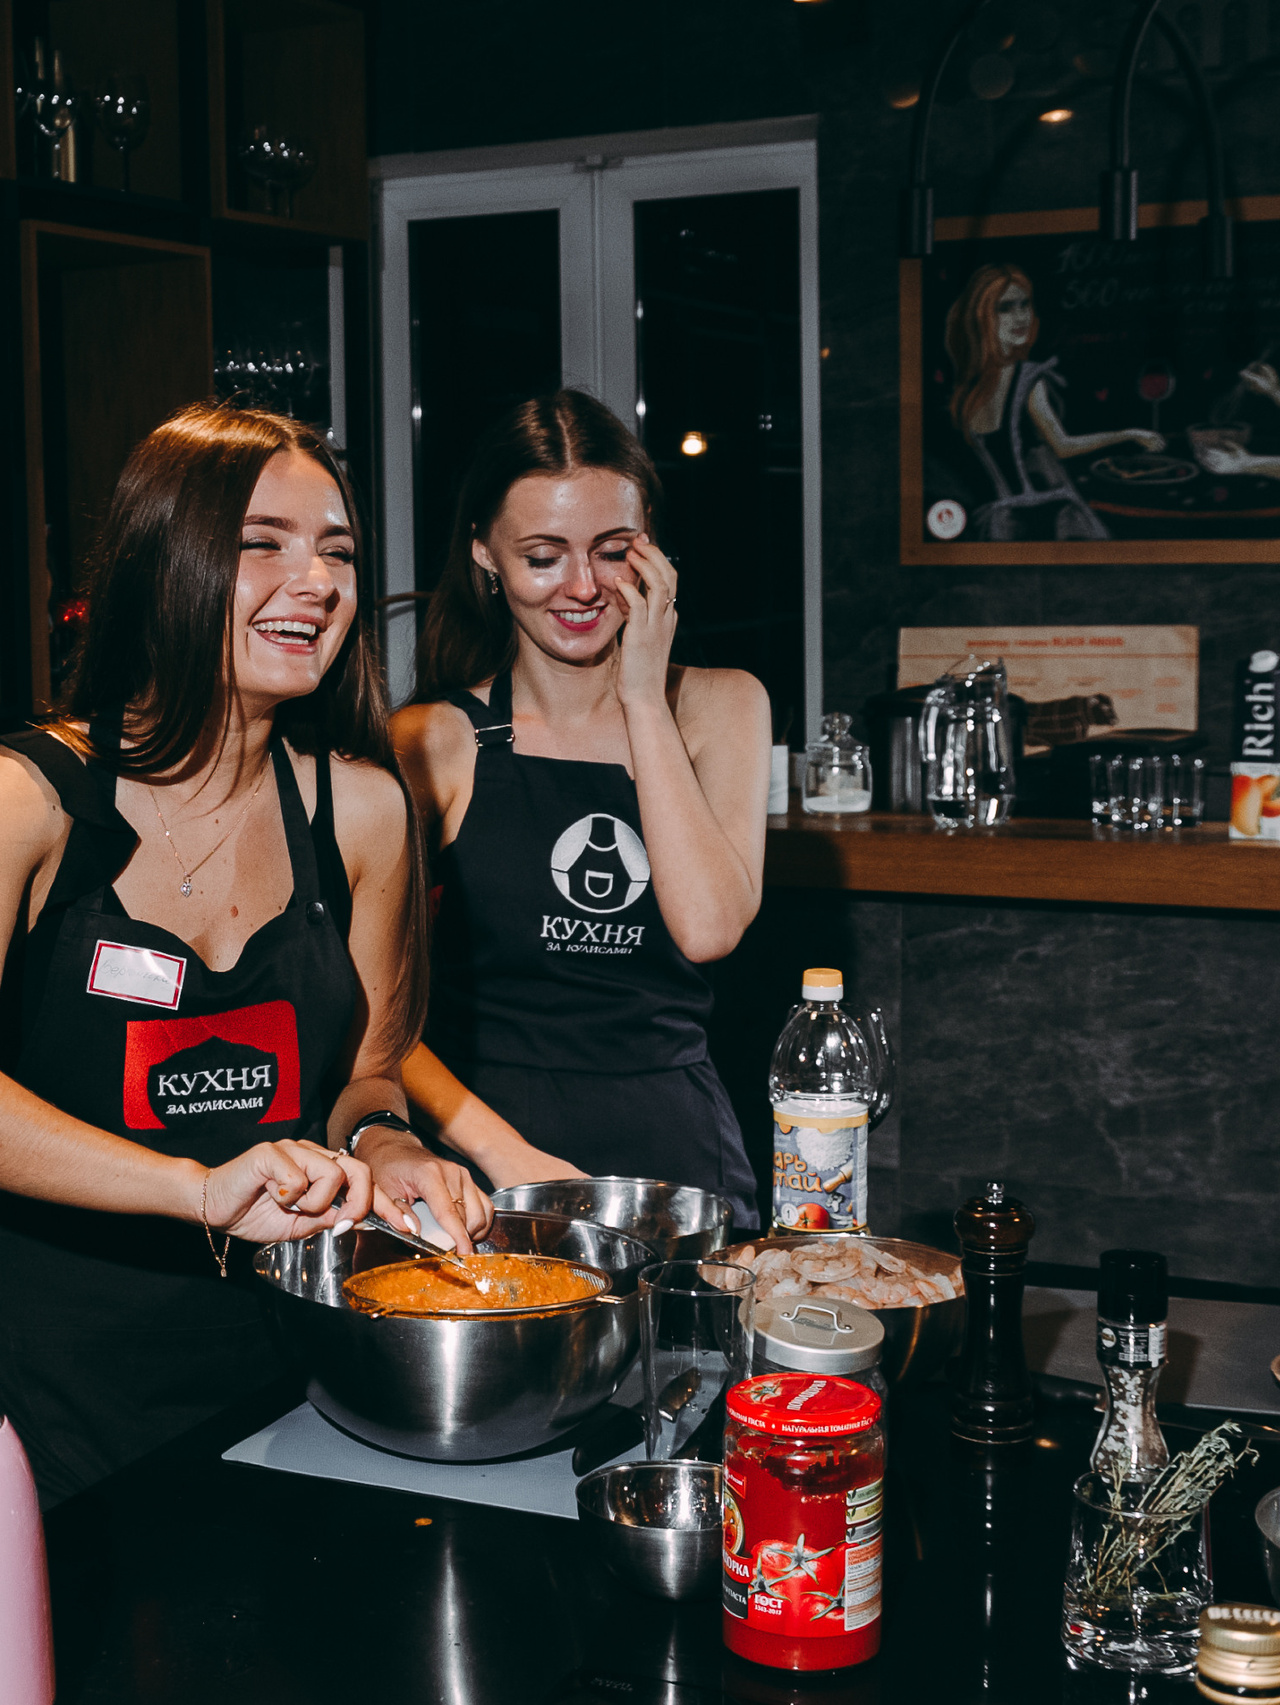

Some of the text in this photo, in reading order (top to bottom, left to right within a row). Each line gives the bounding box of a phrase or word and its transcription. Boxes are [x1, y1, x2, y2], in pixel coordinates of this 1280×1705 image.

[1242, 682, 1275, 756] Rich
[540, 915, 646, 945] КУХНЯ
[546, 941, 633, 955] ЗА КУЛИСАМИ
[157, 1064, 272, 1097] КУХНЯ
[166, 1097, 264, 1115] ЗА КУЛИСАМИ
[773, 1151, 807, 1172] арь
[773, 1169, 823, 1193] тай
[781, 1424, 830, 1433] НАТУРАЛЬНАЯ
[723, 1549, 750, 1578] ОРКА
[754, 1593, 784, 1609] ГОСТ
